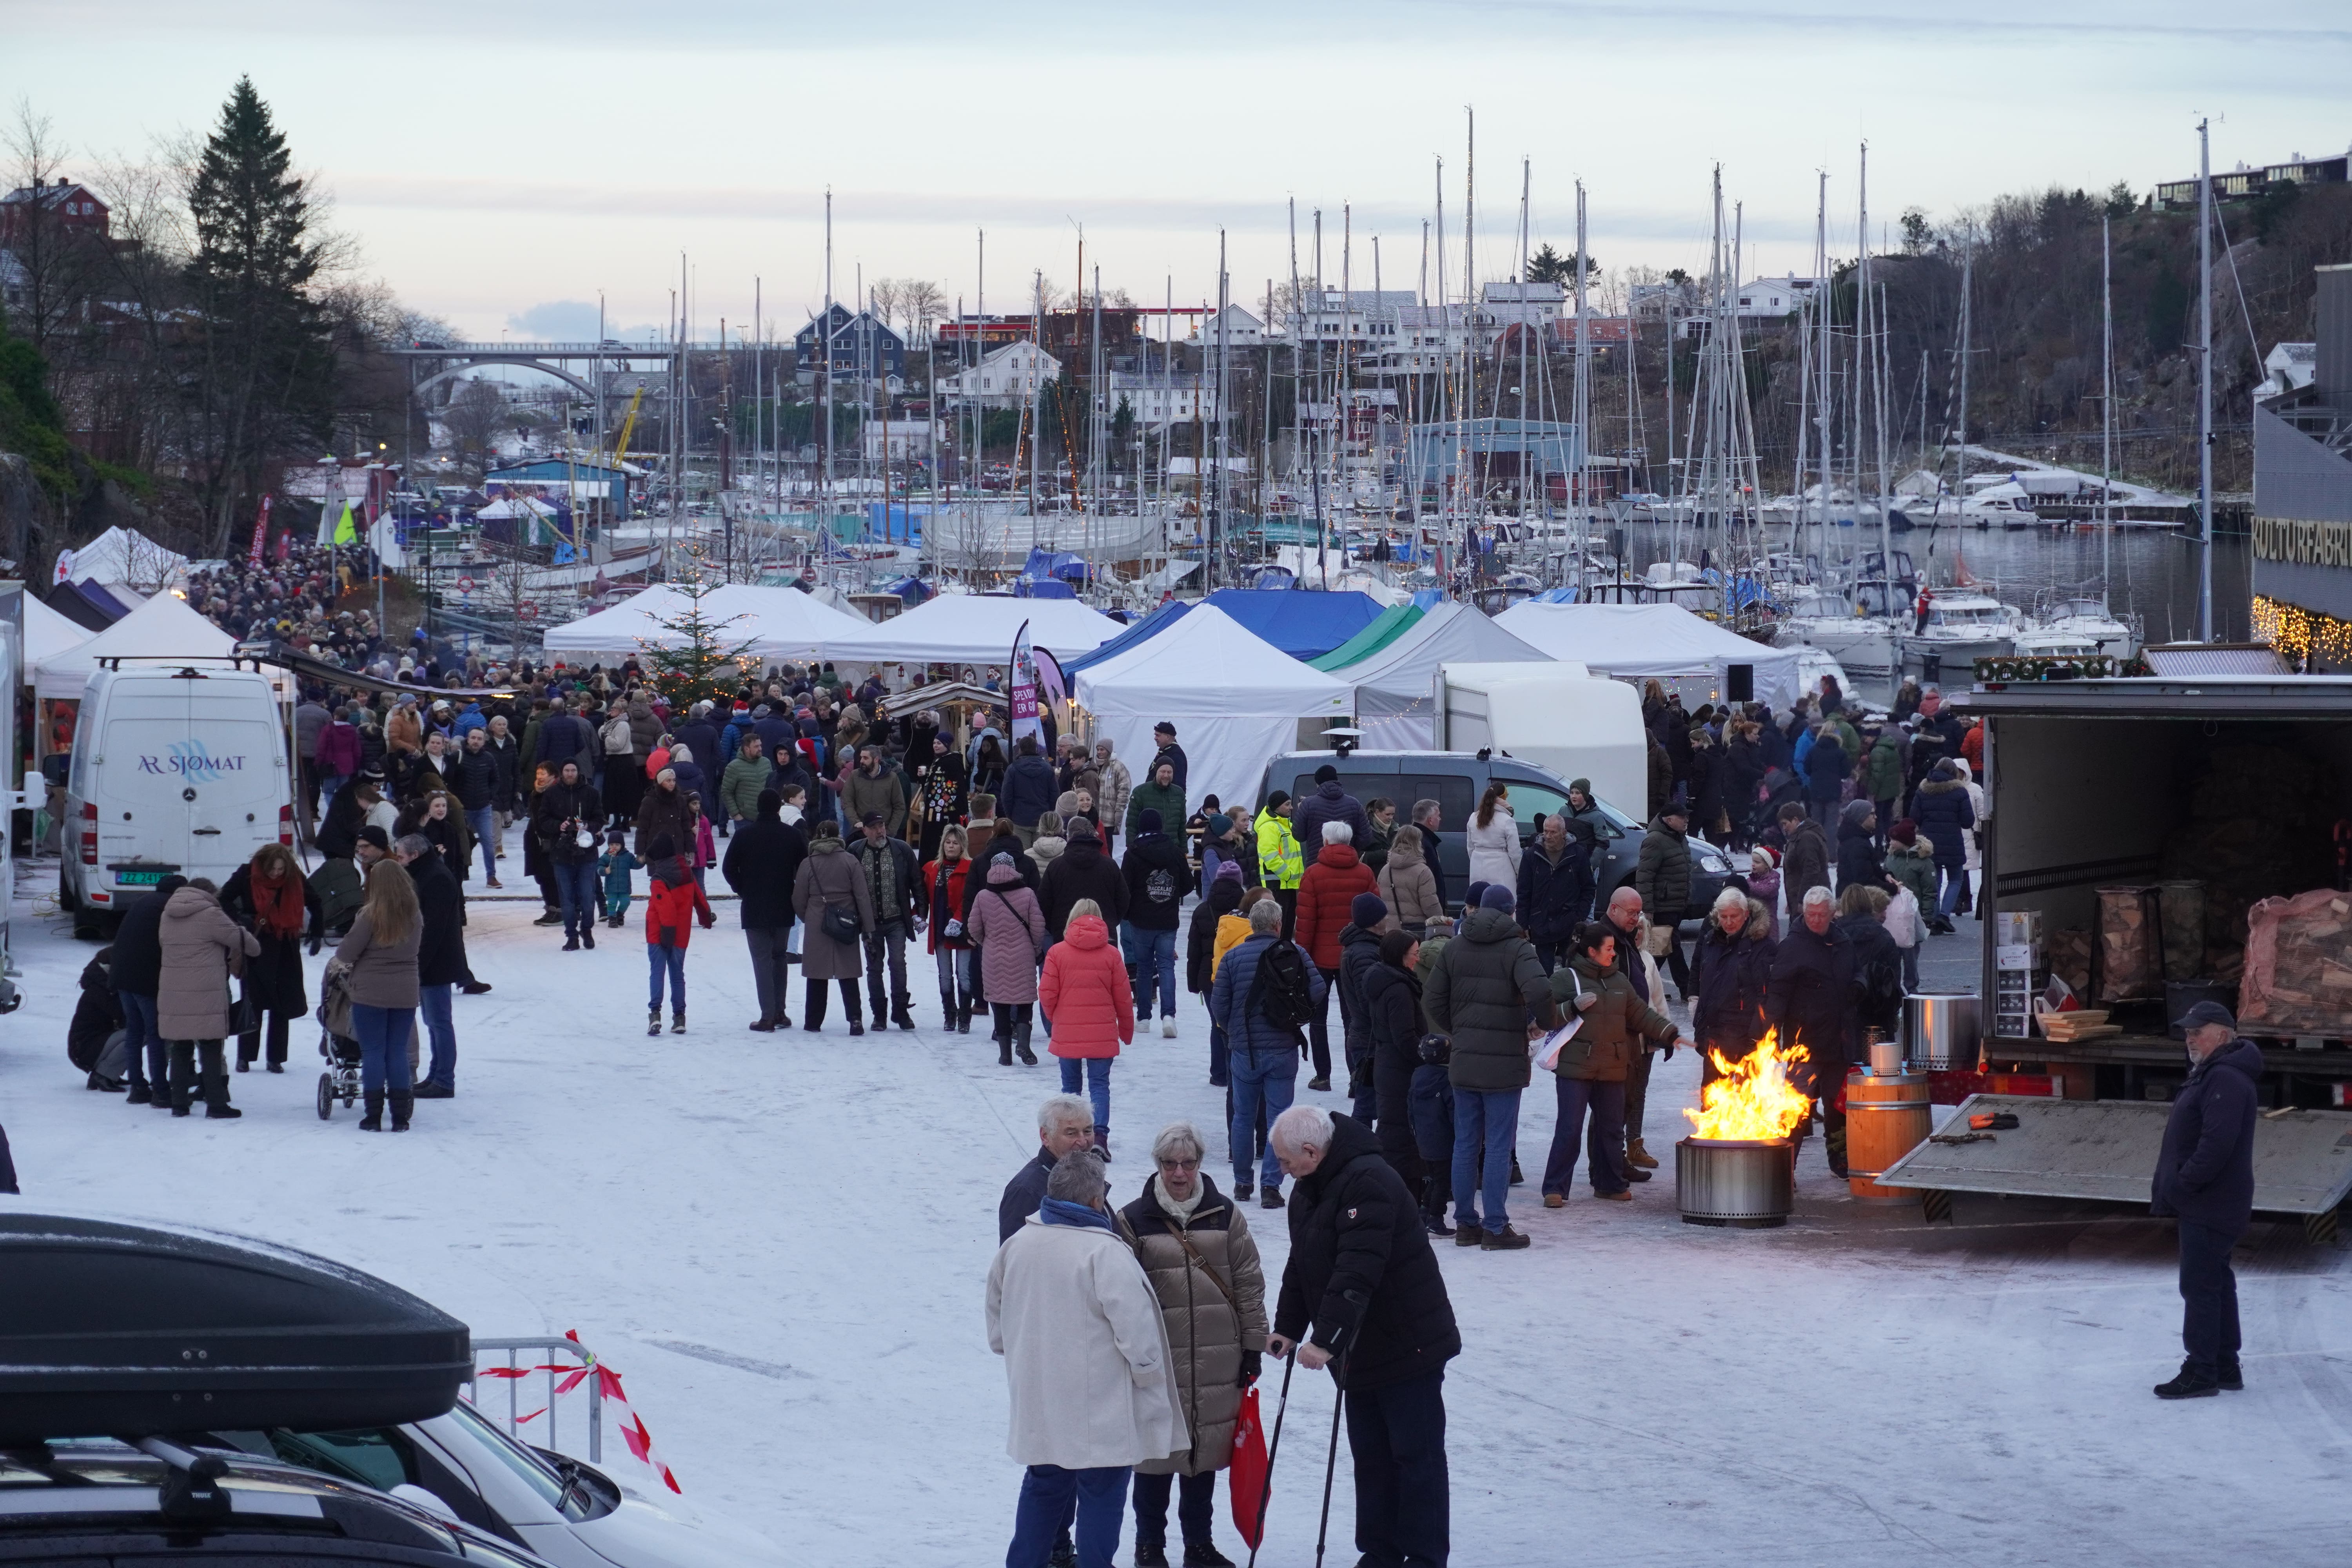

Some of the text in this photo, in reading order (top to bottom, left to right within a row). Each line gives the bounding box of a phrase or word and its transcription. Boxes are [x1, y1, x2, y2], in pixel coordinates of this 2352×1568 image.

[2250, 516, 2352, 567] KULTURFABRI
[1017, 703, 1027, 713] ER
[138, 755, 246, 775] AR SJØMAT
[125, 873, 164, 882] ZZ 241
